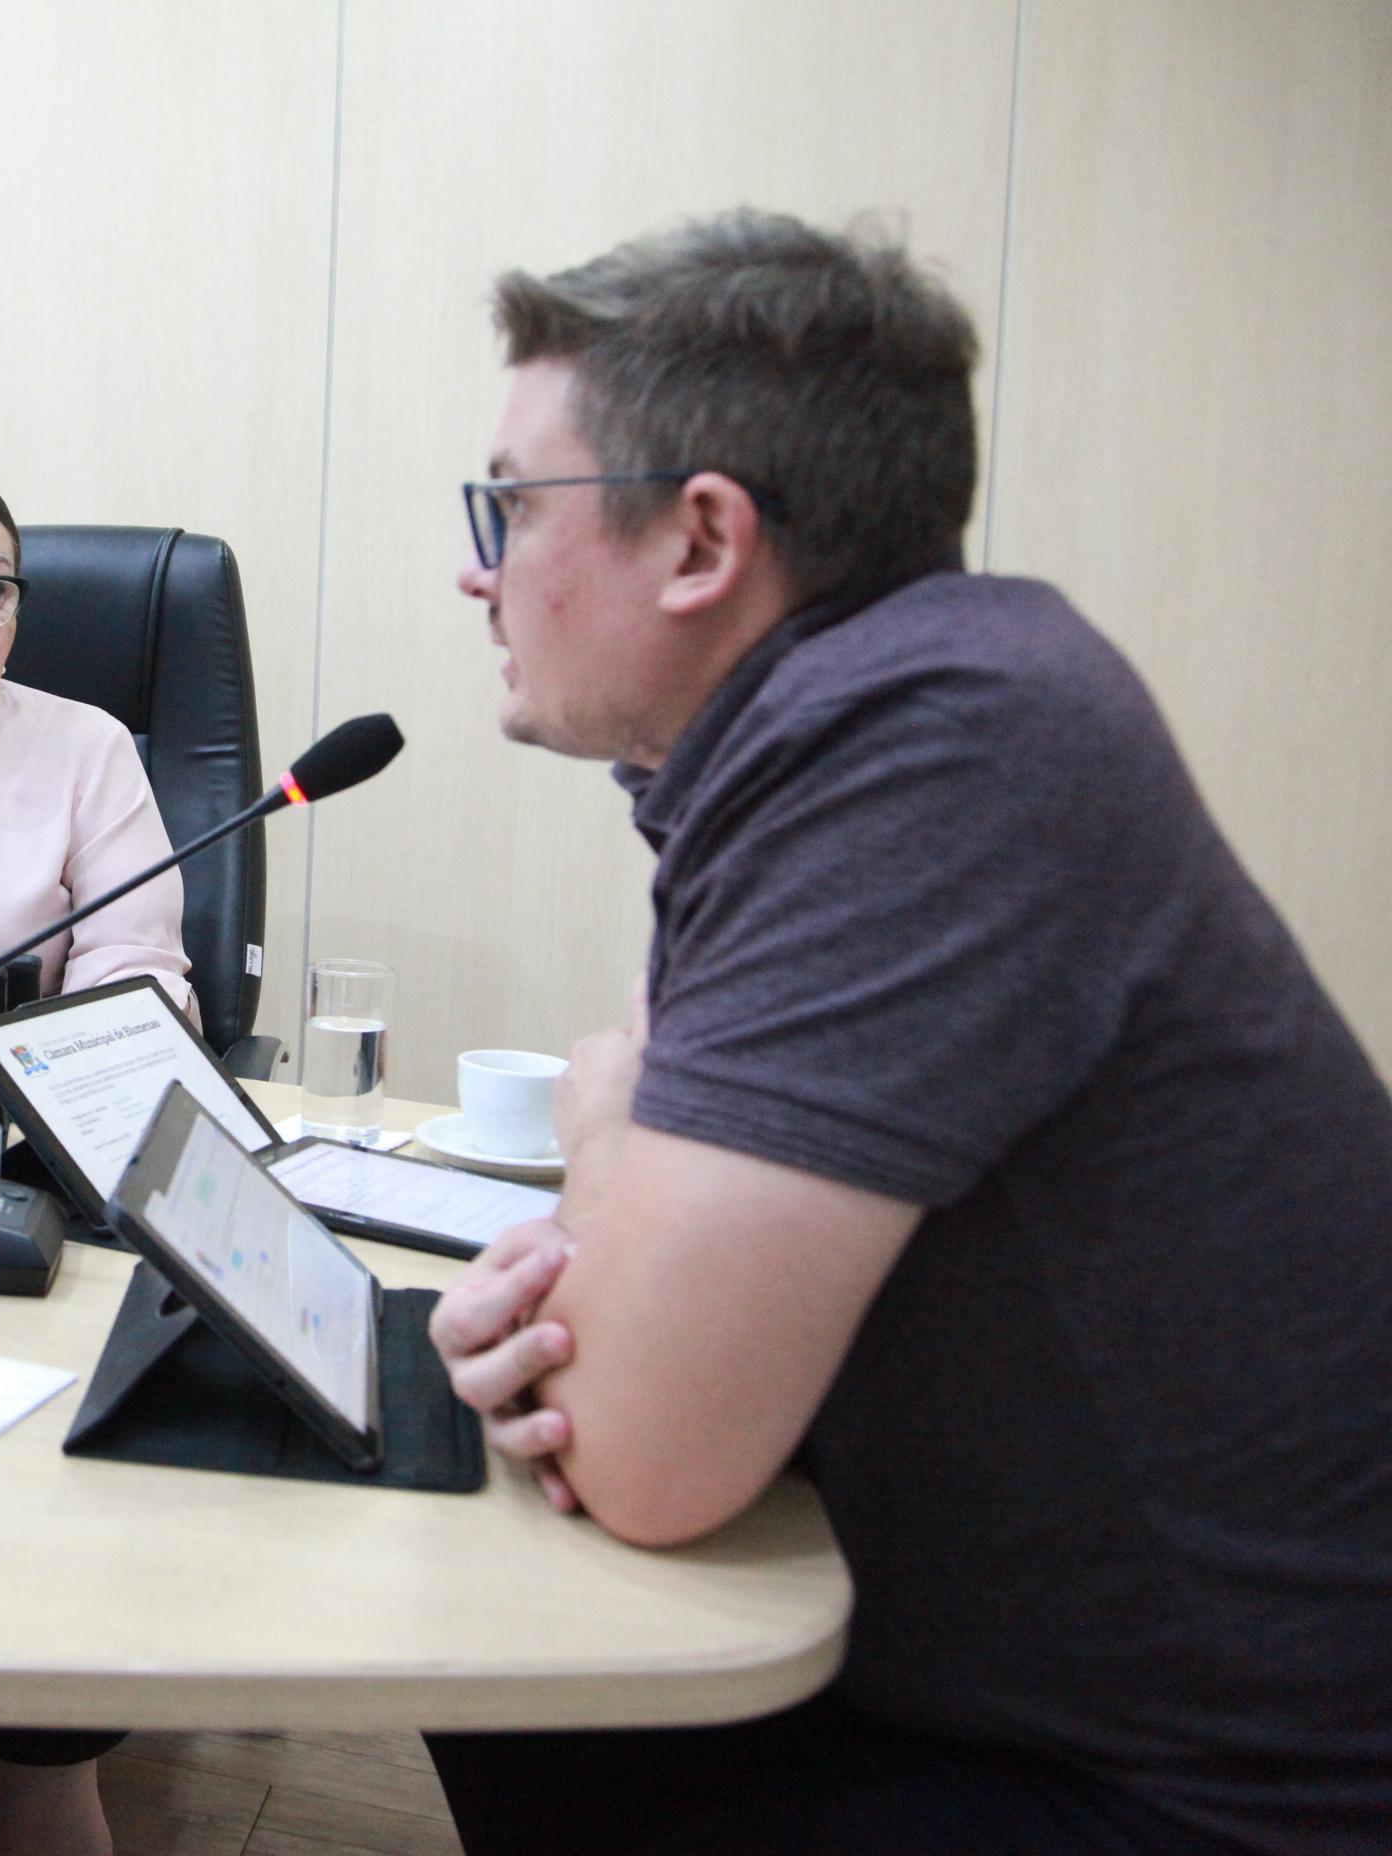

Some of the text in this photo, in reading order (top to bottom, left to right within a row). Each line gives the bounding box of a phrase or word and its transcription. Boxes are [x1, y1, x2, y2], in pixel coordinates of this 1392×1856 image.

[43, 1044, 77, 1061] Câmara
[73, 1030, 115, 1051] Municipal
[113, 1028, 126, 1039] de
[122, 1019, 161, 1037] Blumenau
